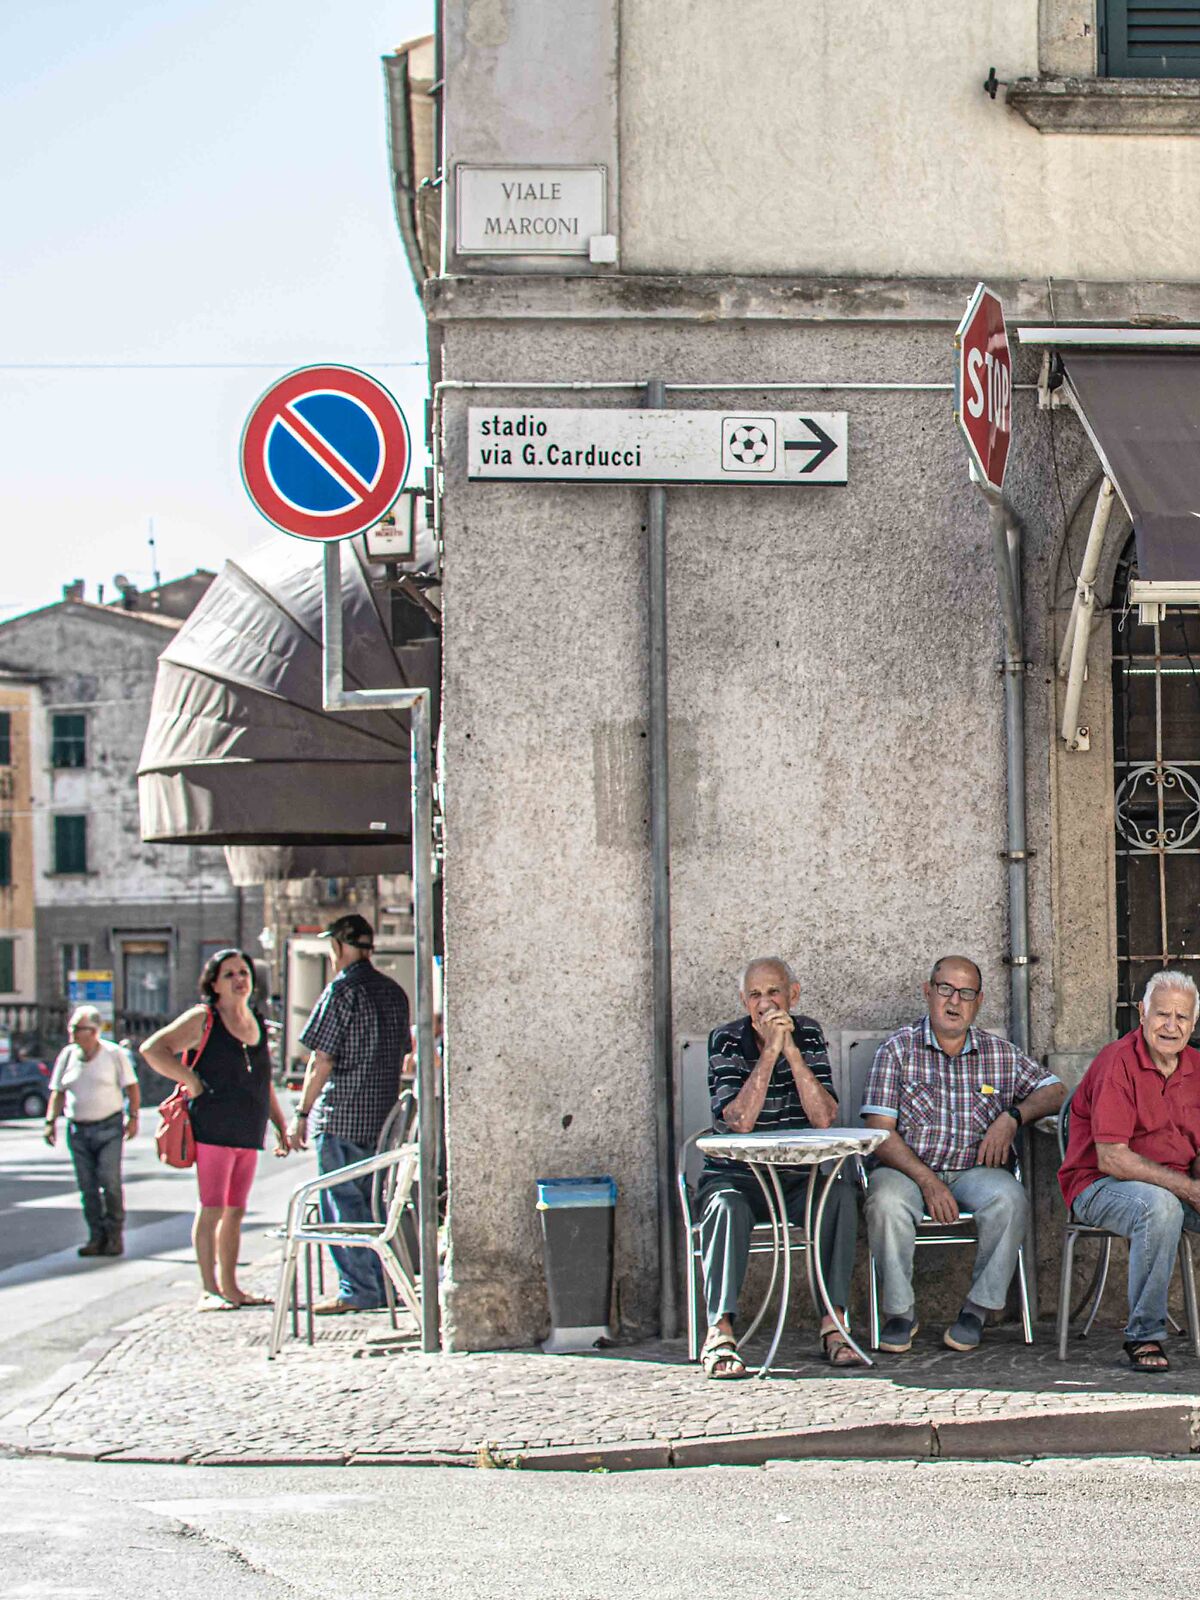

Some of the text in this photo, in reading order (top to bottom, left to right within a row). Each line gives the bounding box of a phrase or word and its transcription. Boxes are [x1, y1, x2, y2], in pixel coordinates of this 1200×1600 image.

[501, 182, 562, 200] VIALE
[484, 217, 579, 235] MARCONI
[967, 347, 1009, 432] STOP
[481, 415, 547, 436] stadio
[481, 445, 512, 466] via
